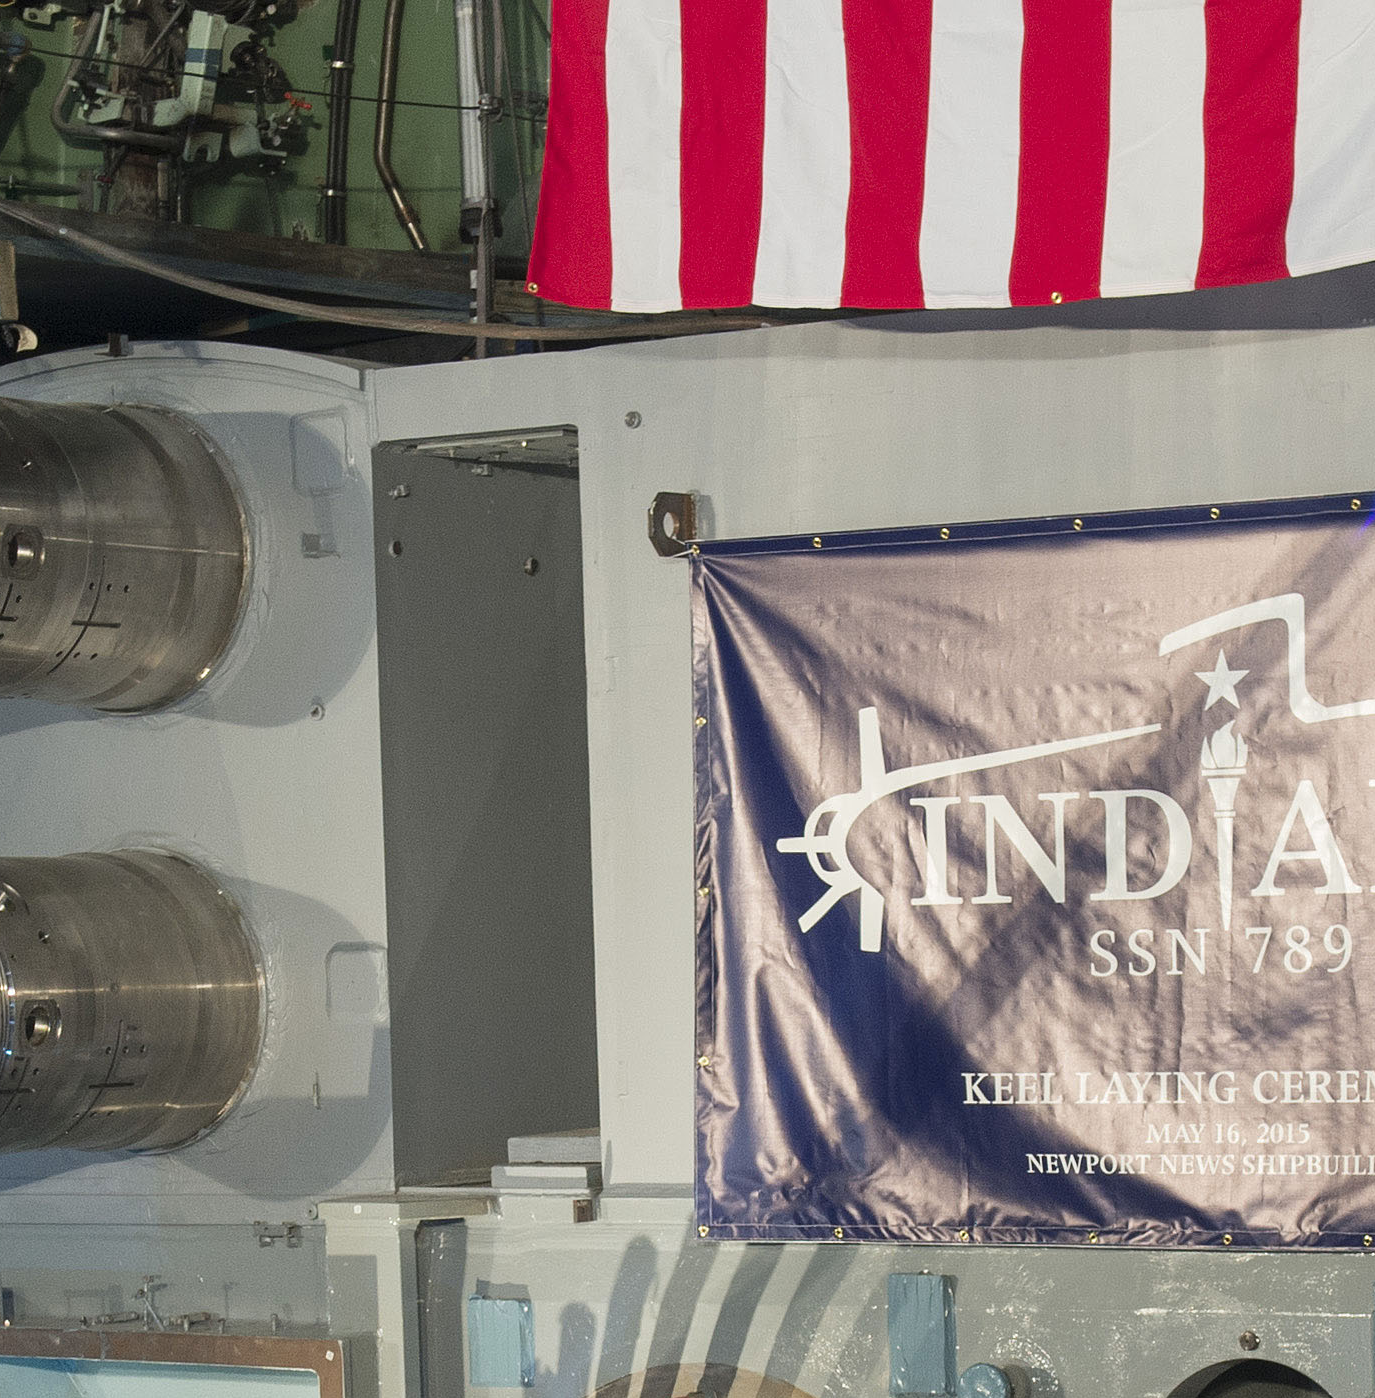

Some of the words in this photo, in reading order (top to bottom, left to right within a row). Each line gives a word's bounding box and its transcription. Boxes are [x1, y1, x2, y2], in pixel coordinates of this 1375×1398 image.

[1089, 928, 1211, 977] SSN
[1244, 923, 1353, 974] 789
[961, 1071, 1063, 1105] KEEL
[1075, 1070, 1240, 1105] LAYING
[1145, 1123, 1206, 1144] MAY
[1215, 1123, 1247, 1147] 16,
[1256, 1123, 1310, 1144] 2015
[1025, 1153, 1152, 1175] NEWPORT
[1159, 1153, 1235, 1175] NEWS
